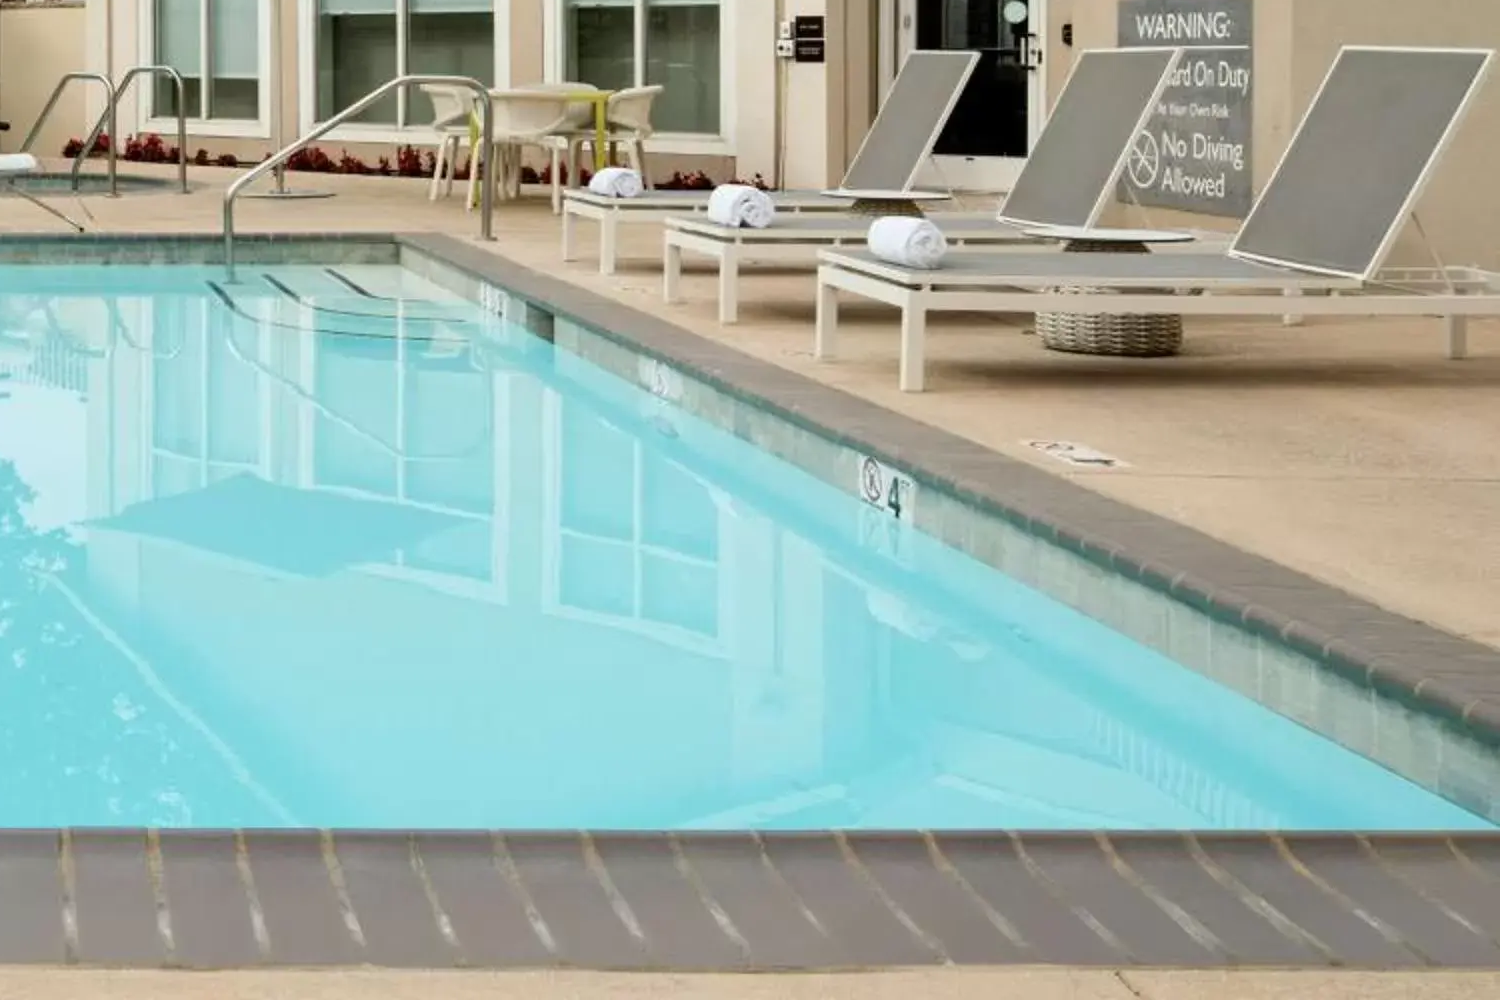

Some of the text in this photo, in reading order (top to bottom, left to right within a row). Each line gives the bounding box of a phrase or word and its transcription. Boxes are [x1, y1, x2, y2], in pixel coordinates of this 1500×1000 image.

[1136, 12, 1231, 40] WARNING:
[1195, 61, 1214, 87] On
[1218, 61, 1250, 96] Duty
[1170, 105, 1188, 116] Your
[1190, 103, 1210, 117] Own
[1211, 104, 1229, 118] Risk
[1162, 131, 1244, 170] No Diving
[1162, 168, 1225, 198] Allowed
[888, 476, 901, 519] 4
